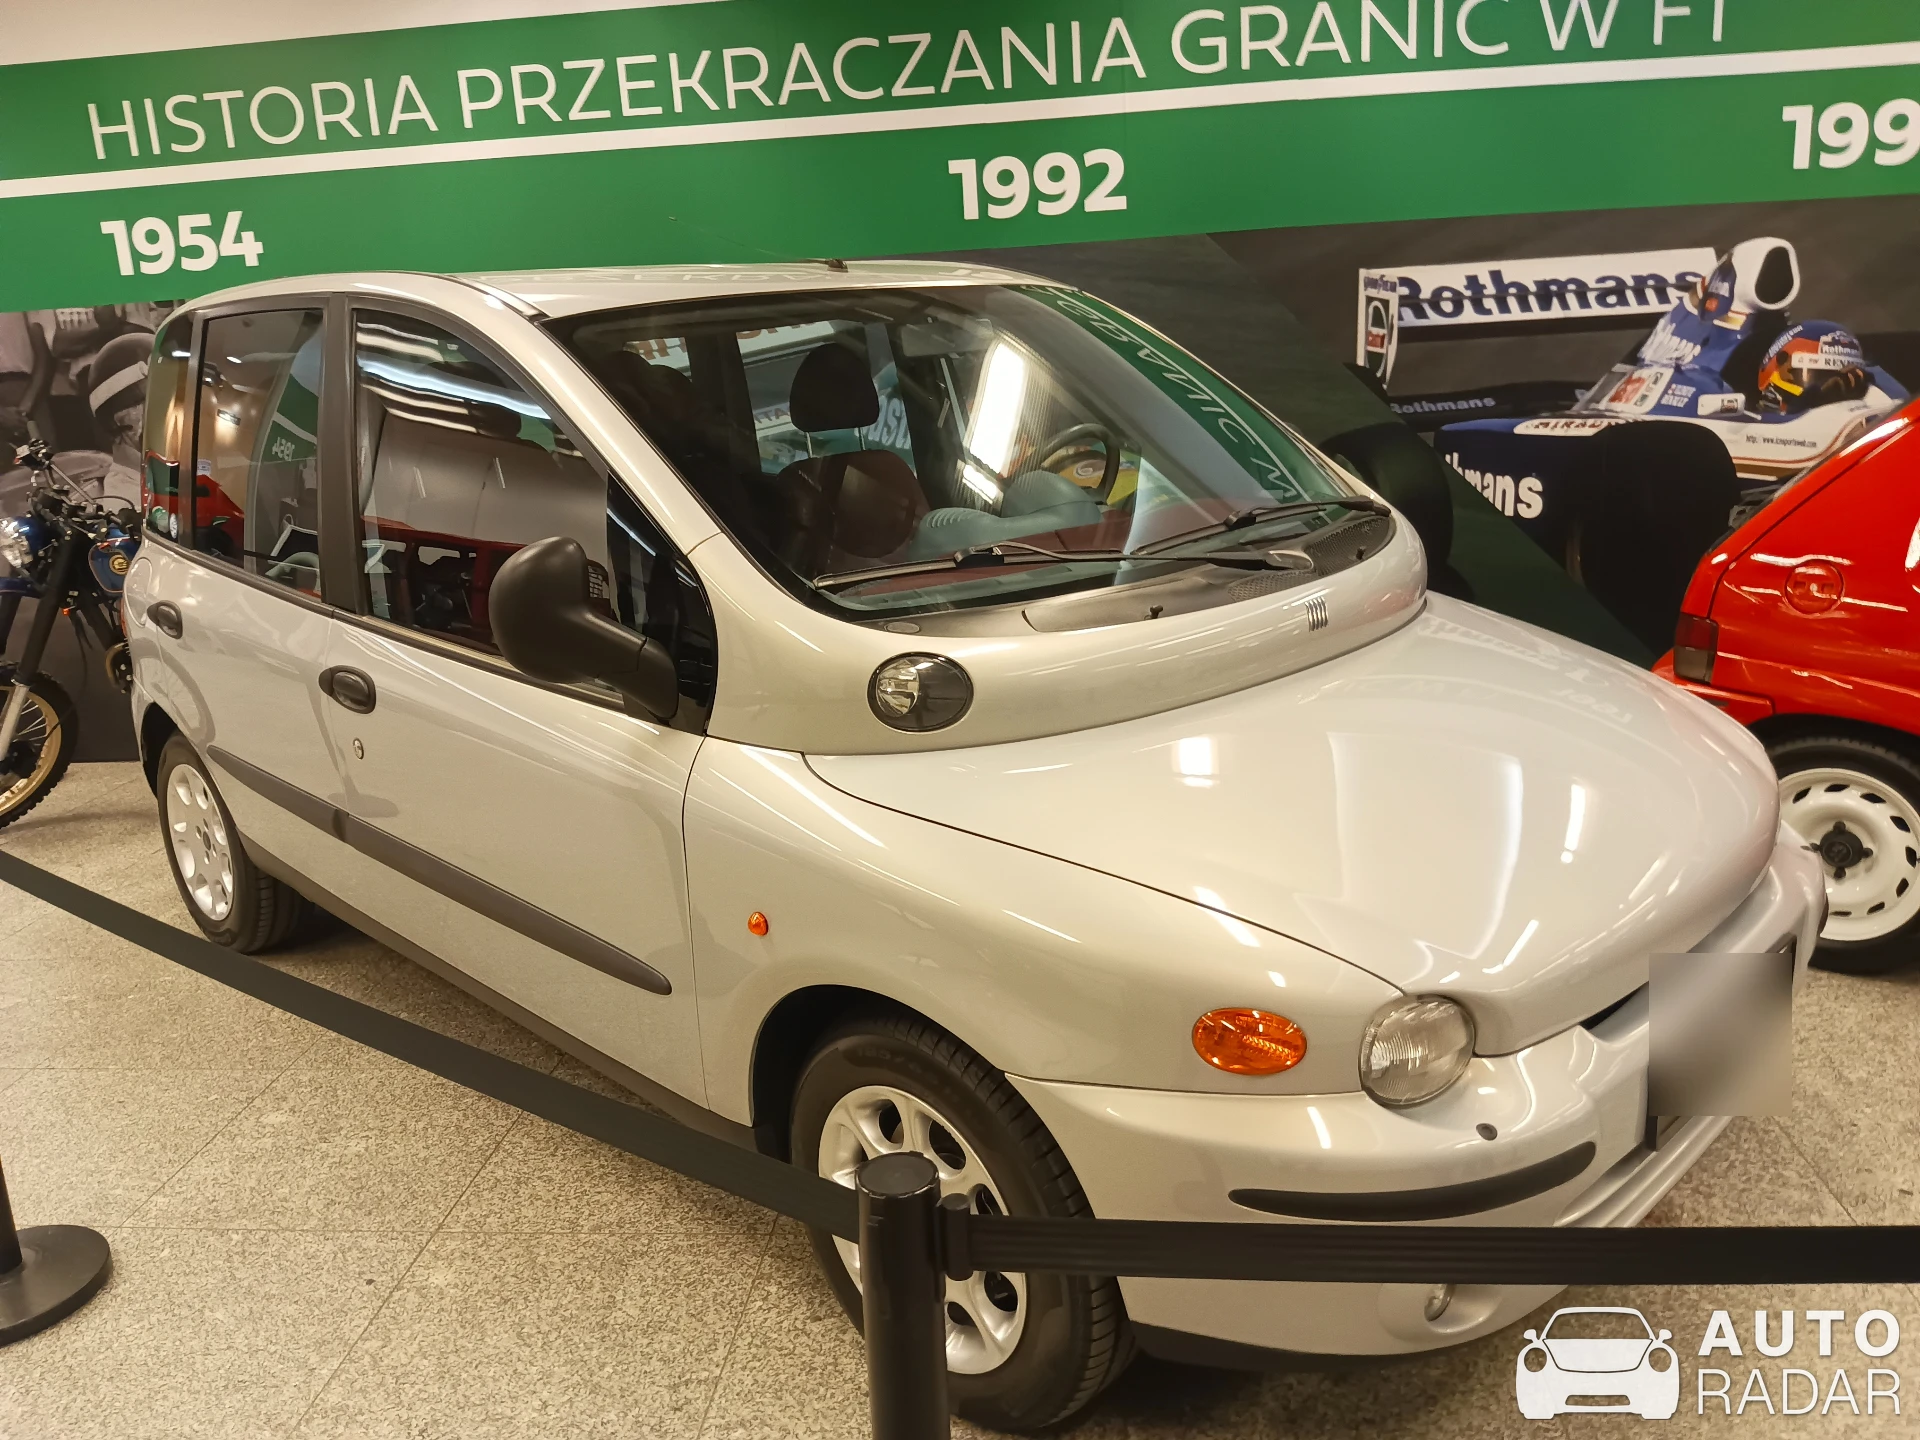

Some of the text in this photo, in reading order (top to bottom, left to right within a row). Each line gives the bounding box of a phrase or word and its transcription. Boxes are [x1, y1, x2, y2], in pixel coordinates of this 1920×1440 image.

[87, 75, 440, 161] HISTORIA
[457, 17, 1148, 131] PRZEKRACZANIA
[1172, 0, 1510, 76] GRANIC
[1540, 0, 1620, 51] W
[100, 210, 265, 277] 1954
[948, 148, 1128, 221] 1992
